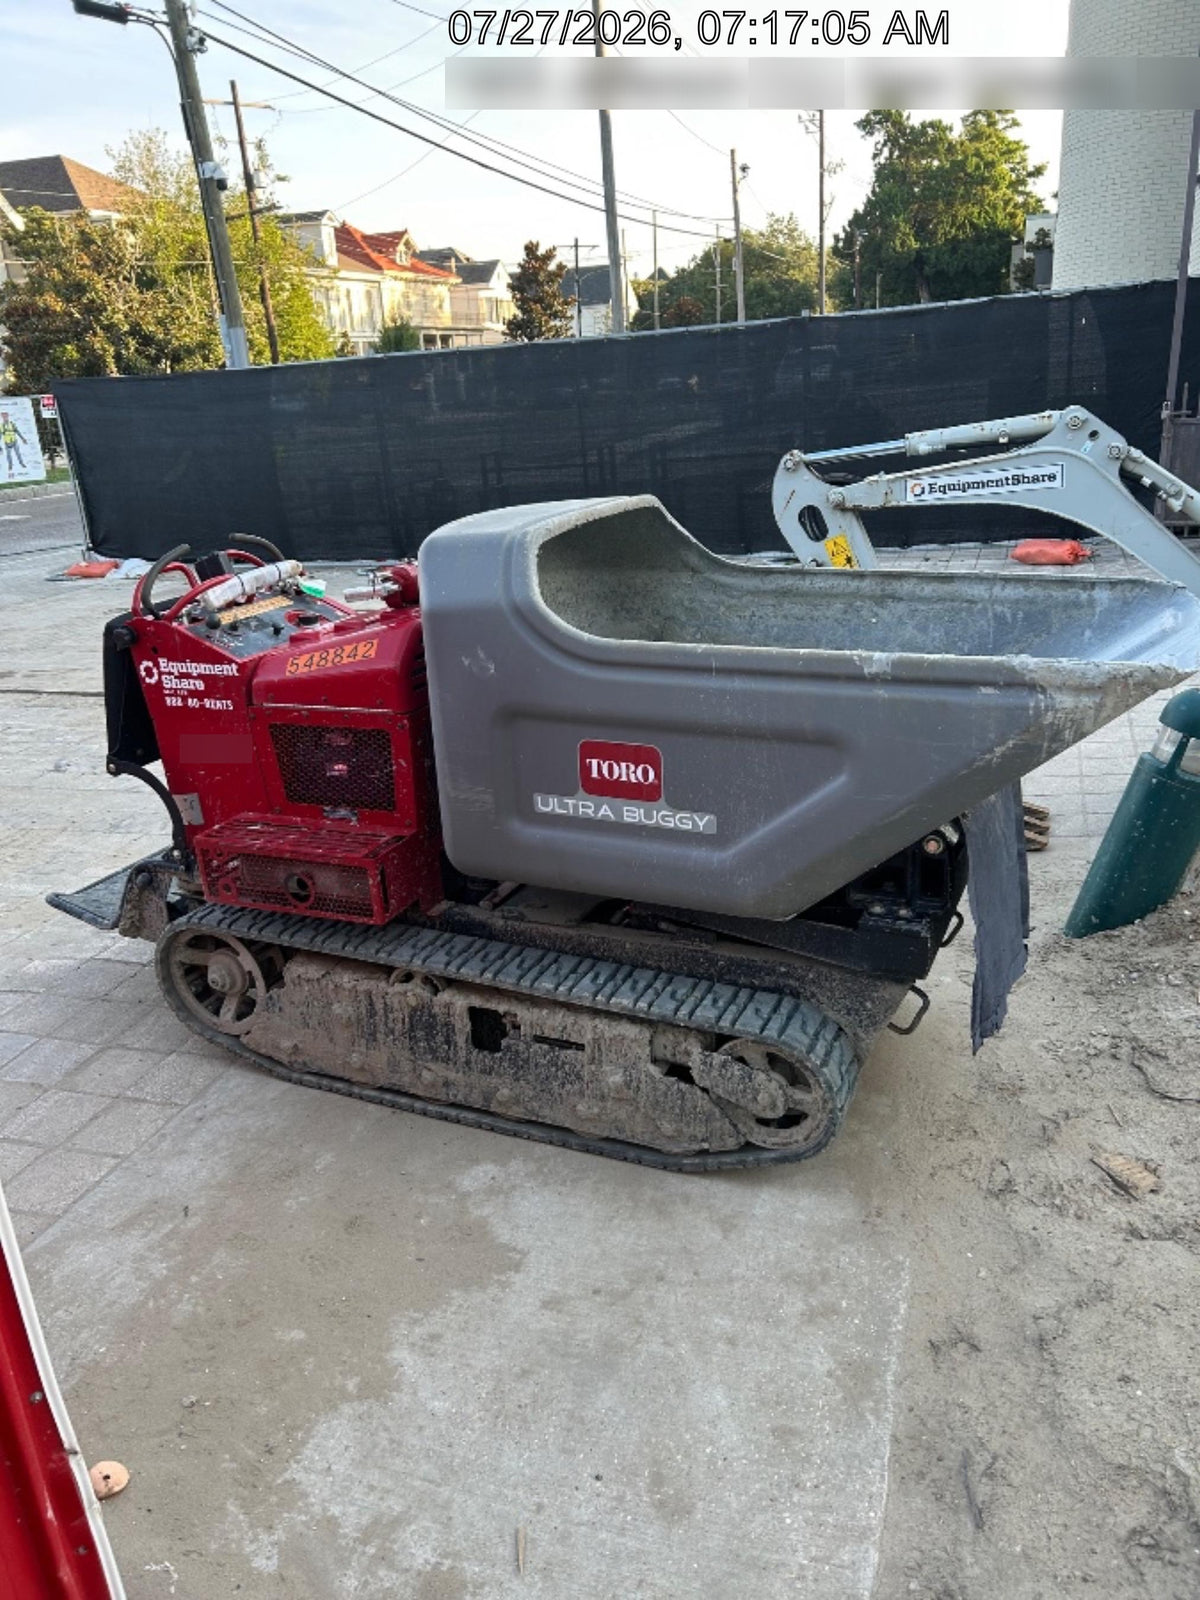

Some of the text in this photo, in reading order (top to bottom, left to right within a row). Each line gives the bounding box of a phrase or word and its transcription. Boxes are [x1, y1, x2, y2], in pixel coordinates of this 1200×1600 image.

[927, 472, 1058, 495] EquipmentShare
[158, 657, 240, 676] Equipment
[287, 641, 374, 675] 548842
[161, 675, 205, 690] Share
[586, 758, 655, 785] TORO
[537, 796, 710, 832] ULTRA BUGGY
